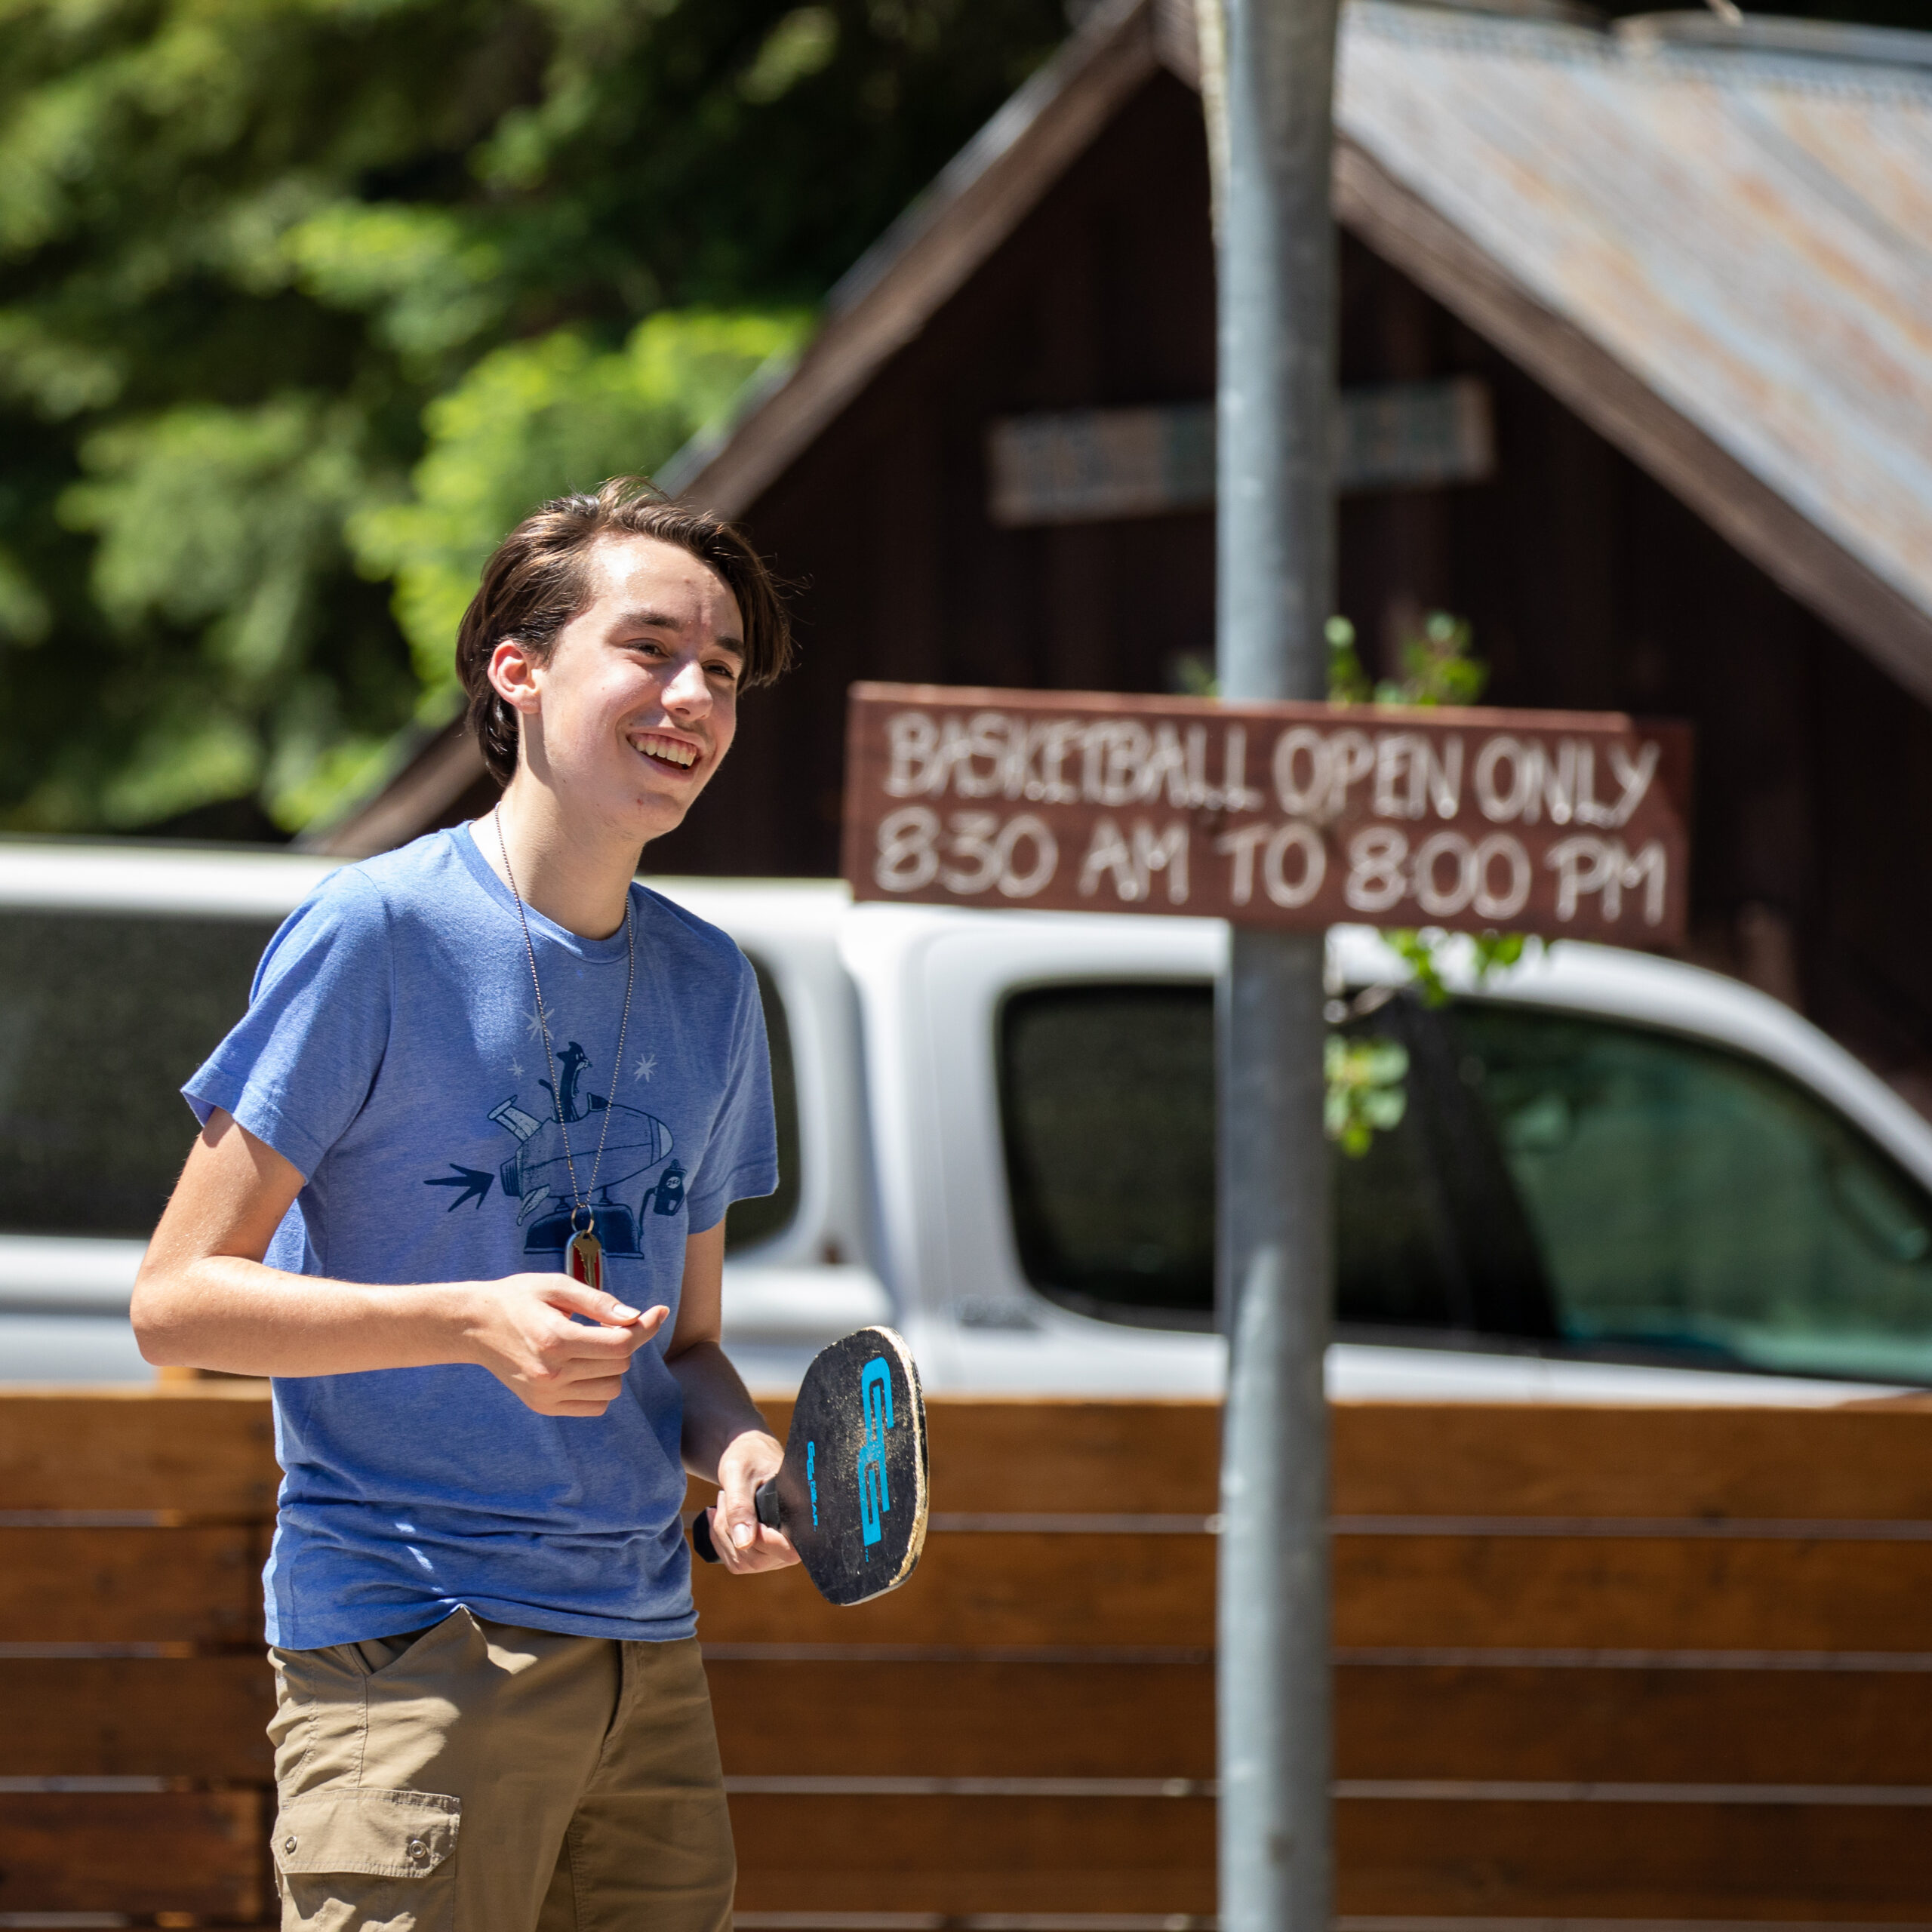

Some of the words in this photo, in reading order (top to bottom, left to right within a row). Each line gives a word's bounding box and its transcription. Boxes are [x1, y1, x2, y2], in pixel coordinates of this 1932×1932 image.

[884, 710, 1264, 811] BASKETBALL
[1273, 724, 1463, 820] OPEN
[1473, 734, 1660, 829] ONLY
[1077, 816, 1190, 905] AM
[1211, 822, 1326, 909] TO
[1544, 834, 1666, 927] PM
